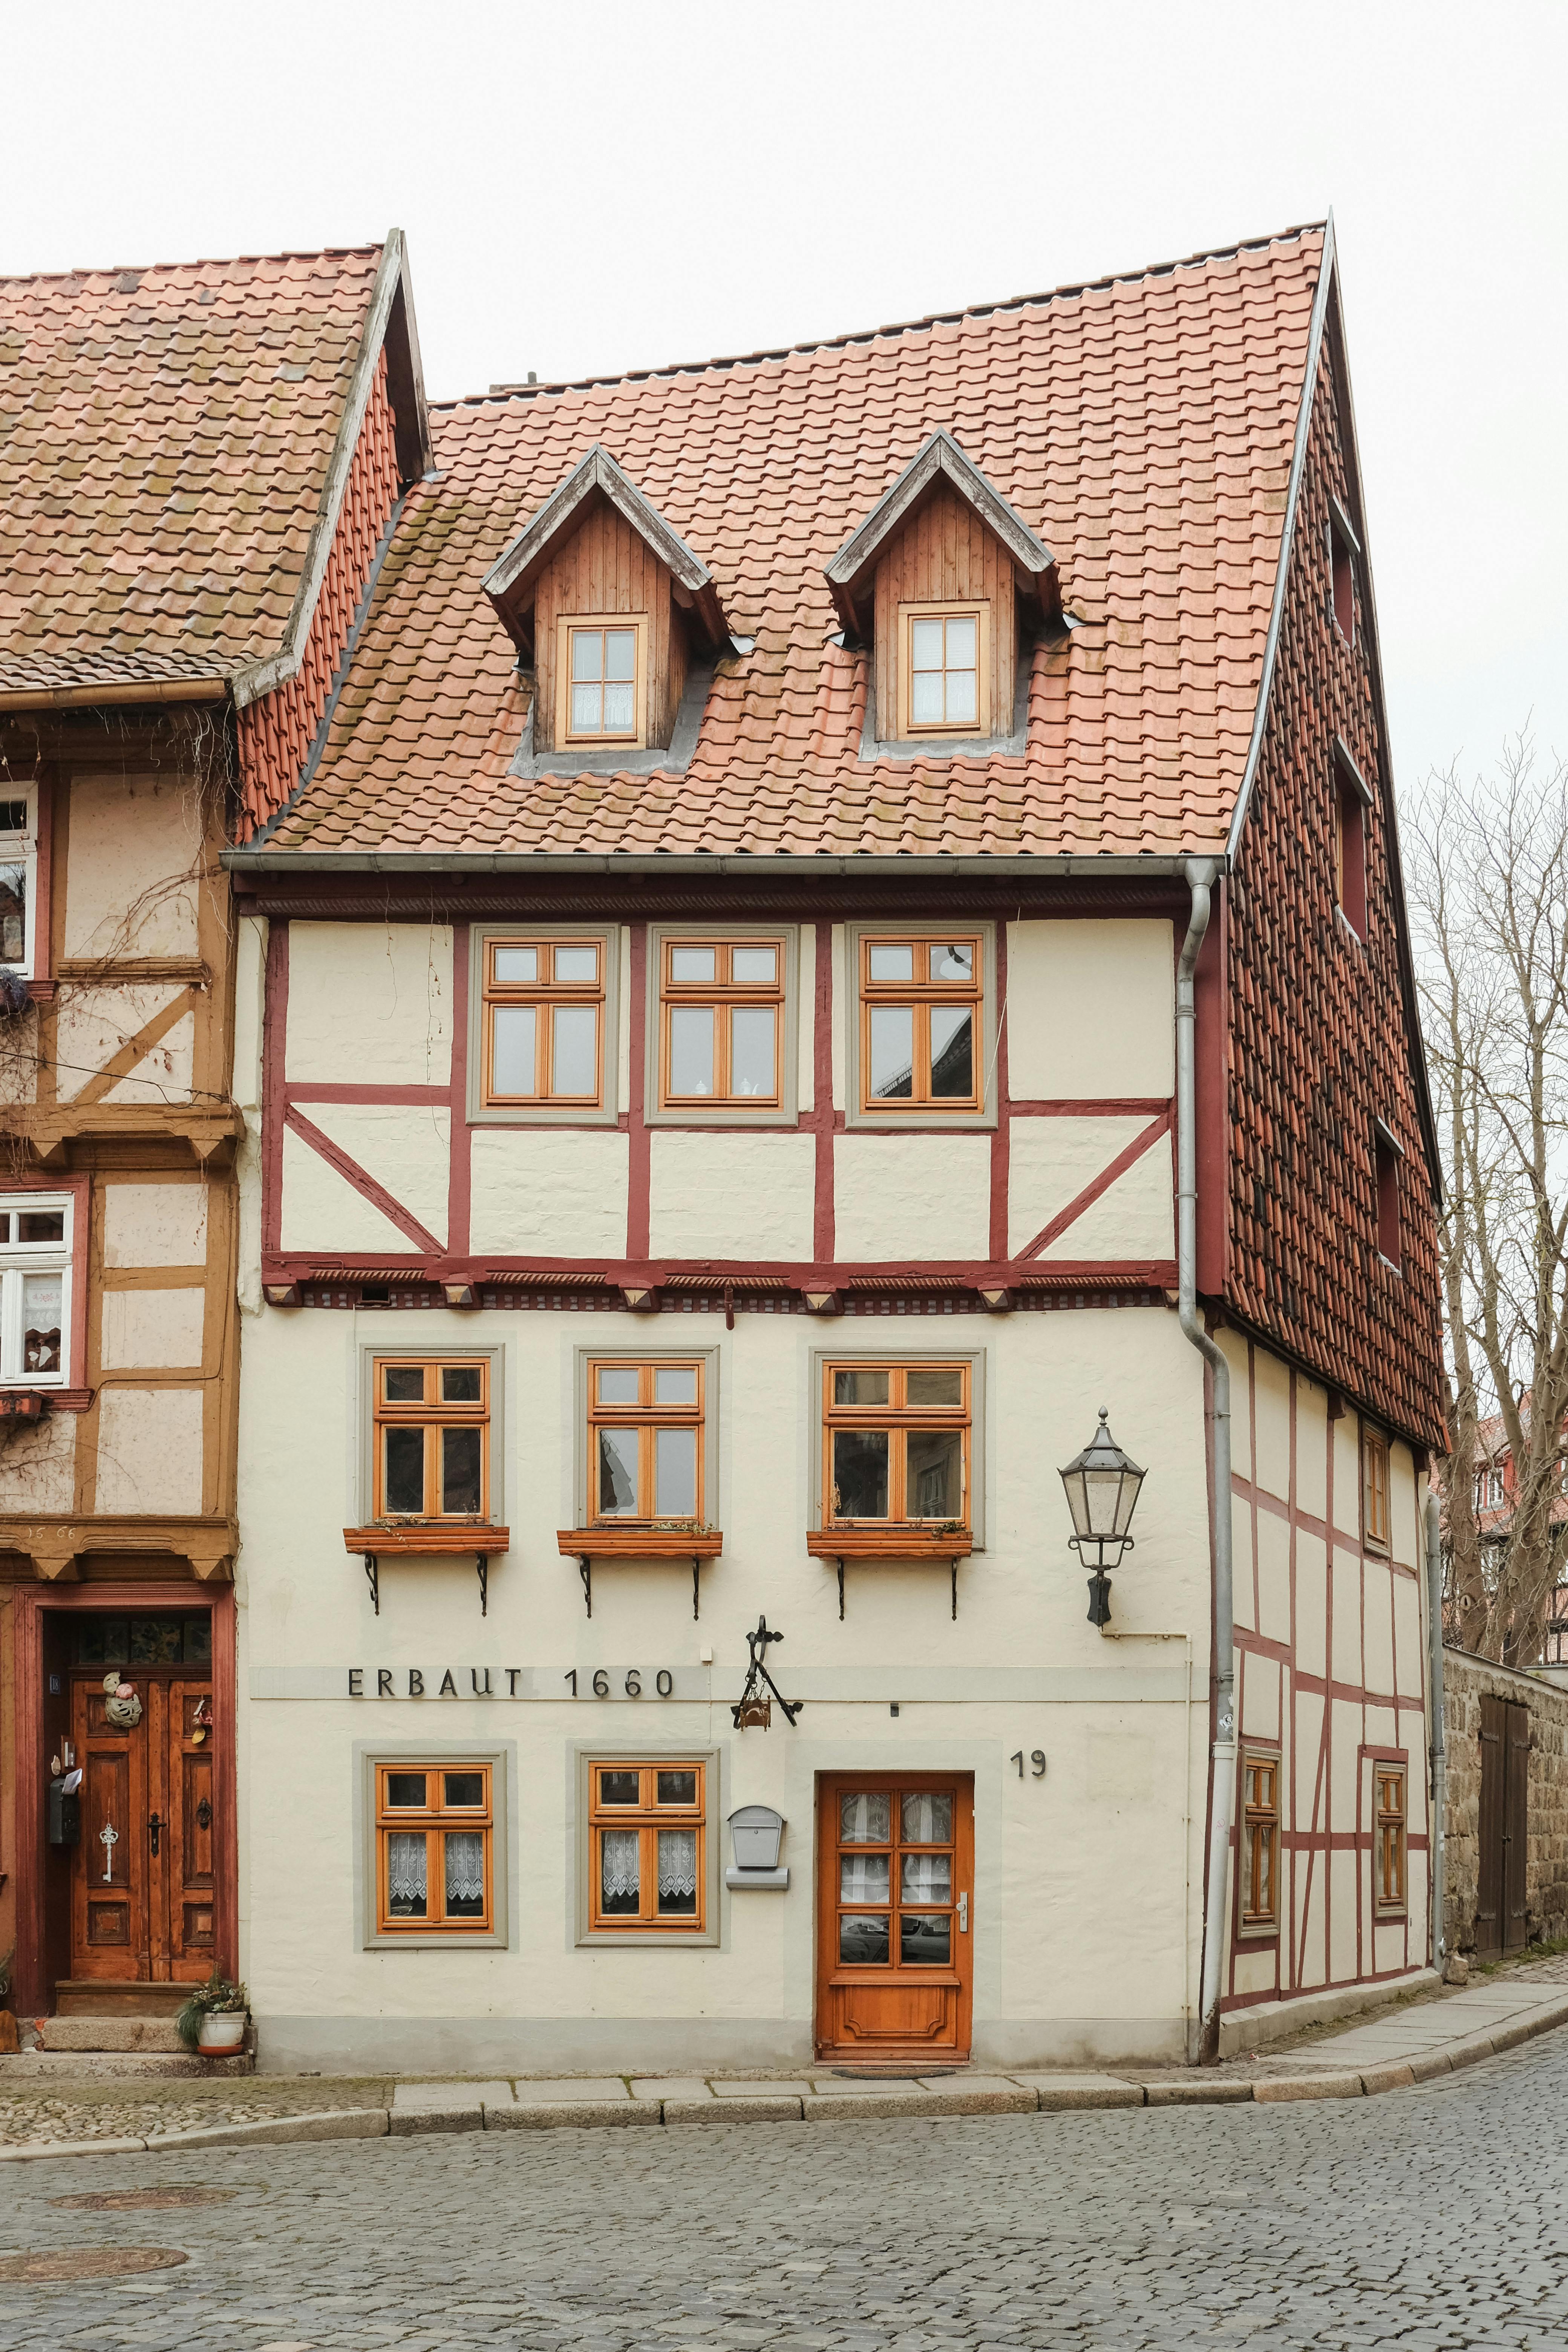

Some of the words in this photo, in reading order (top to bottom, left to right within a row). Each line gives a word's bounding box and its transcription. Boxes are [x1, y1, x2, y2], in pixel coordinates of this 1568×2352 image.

[53, 1678, 59, 1690] 18
[349, 1668, 521, 1697] ERBAUT
[564, 1669, 672, 1697] 1660
[1010, 1750, 1046, 1777] 19
